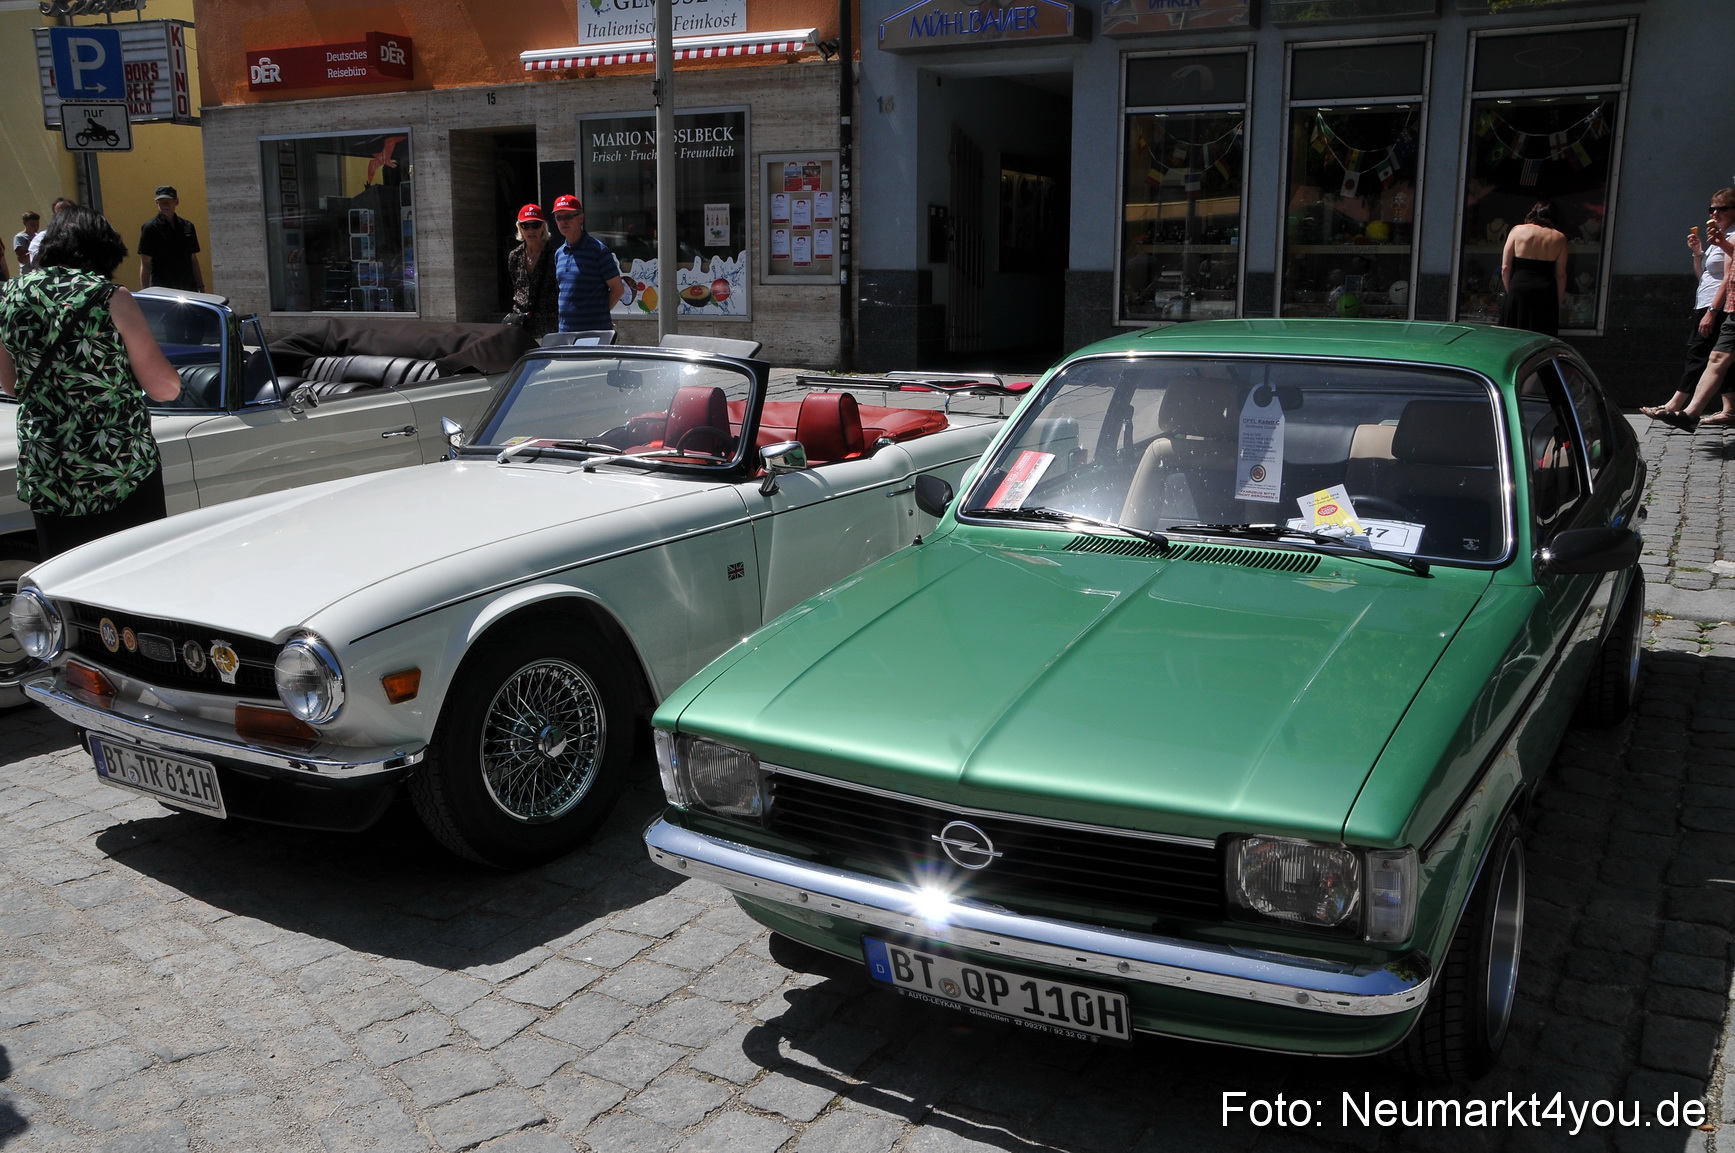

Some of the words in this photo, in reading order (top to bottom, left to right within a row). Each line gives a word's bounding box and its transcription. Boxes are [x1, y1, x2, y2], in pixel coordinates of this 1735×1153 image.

[672, 12, 737, 32] Feinkost
[909, 5, 1039, 38] MÜHLBAUER
[67, 37, 106, 91] P
[380, 44, 406, 66] DER
[170, 25, 188, 115] KINO
[250, 63, 282, 84] DER
[326, 50, 368, 62] Deutsches
[327, 66, 367, 79] Reisebüro
[486, 92, 496, 105] 15
[83, 108, 104, 118] nur
[592, 130, 641, 147] MARIO
[645, 126, 734, 145] NSSLBECK
[592, 151, 622, 162] Frisch
[630, 149, 657, 162] Fruch
[680, 145, 734, 159] Freundlich
[1362, 526, 1389, 538] 47
[103, 744, 126, 777] BT
[876, 963, 885, 974] D
[890, 948, 934, 989] BT
[961, 968, 1009, 1006] QP
[1020, 981, 1124, 1034] 110H
[908, 991, 962, 1011] AUTO-LEYKAM
[1024, 1021, 1048, 1032] 09279
